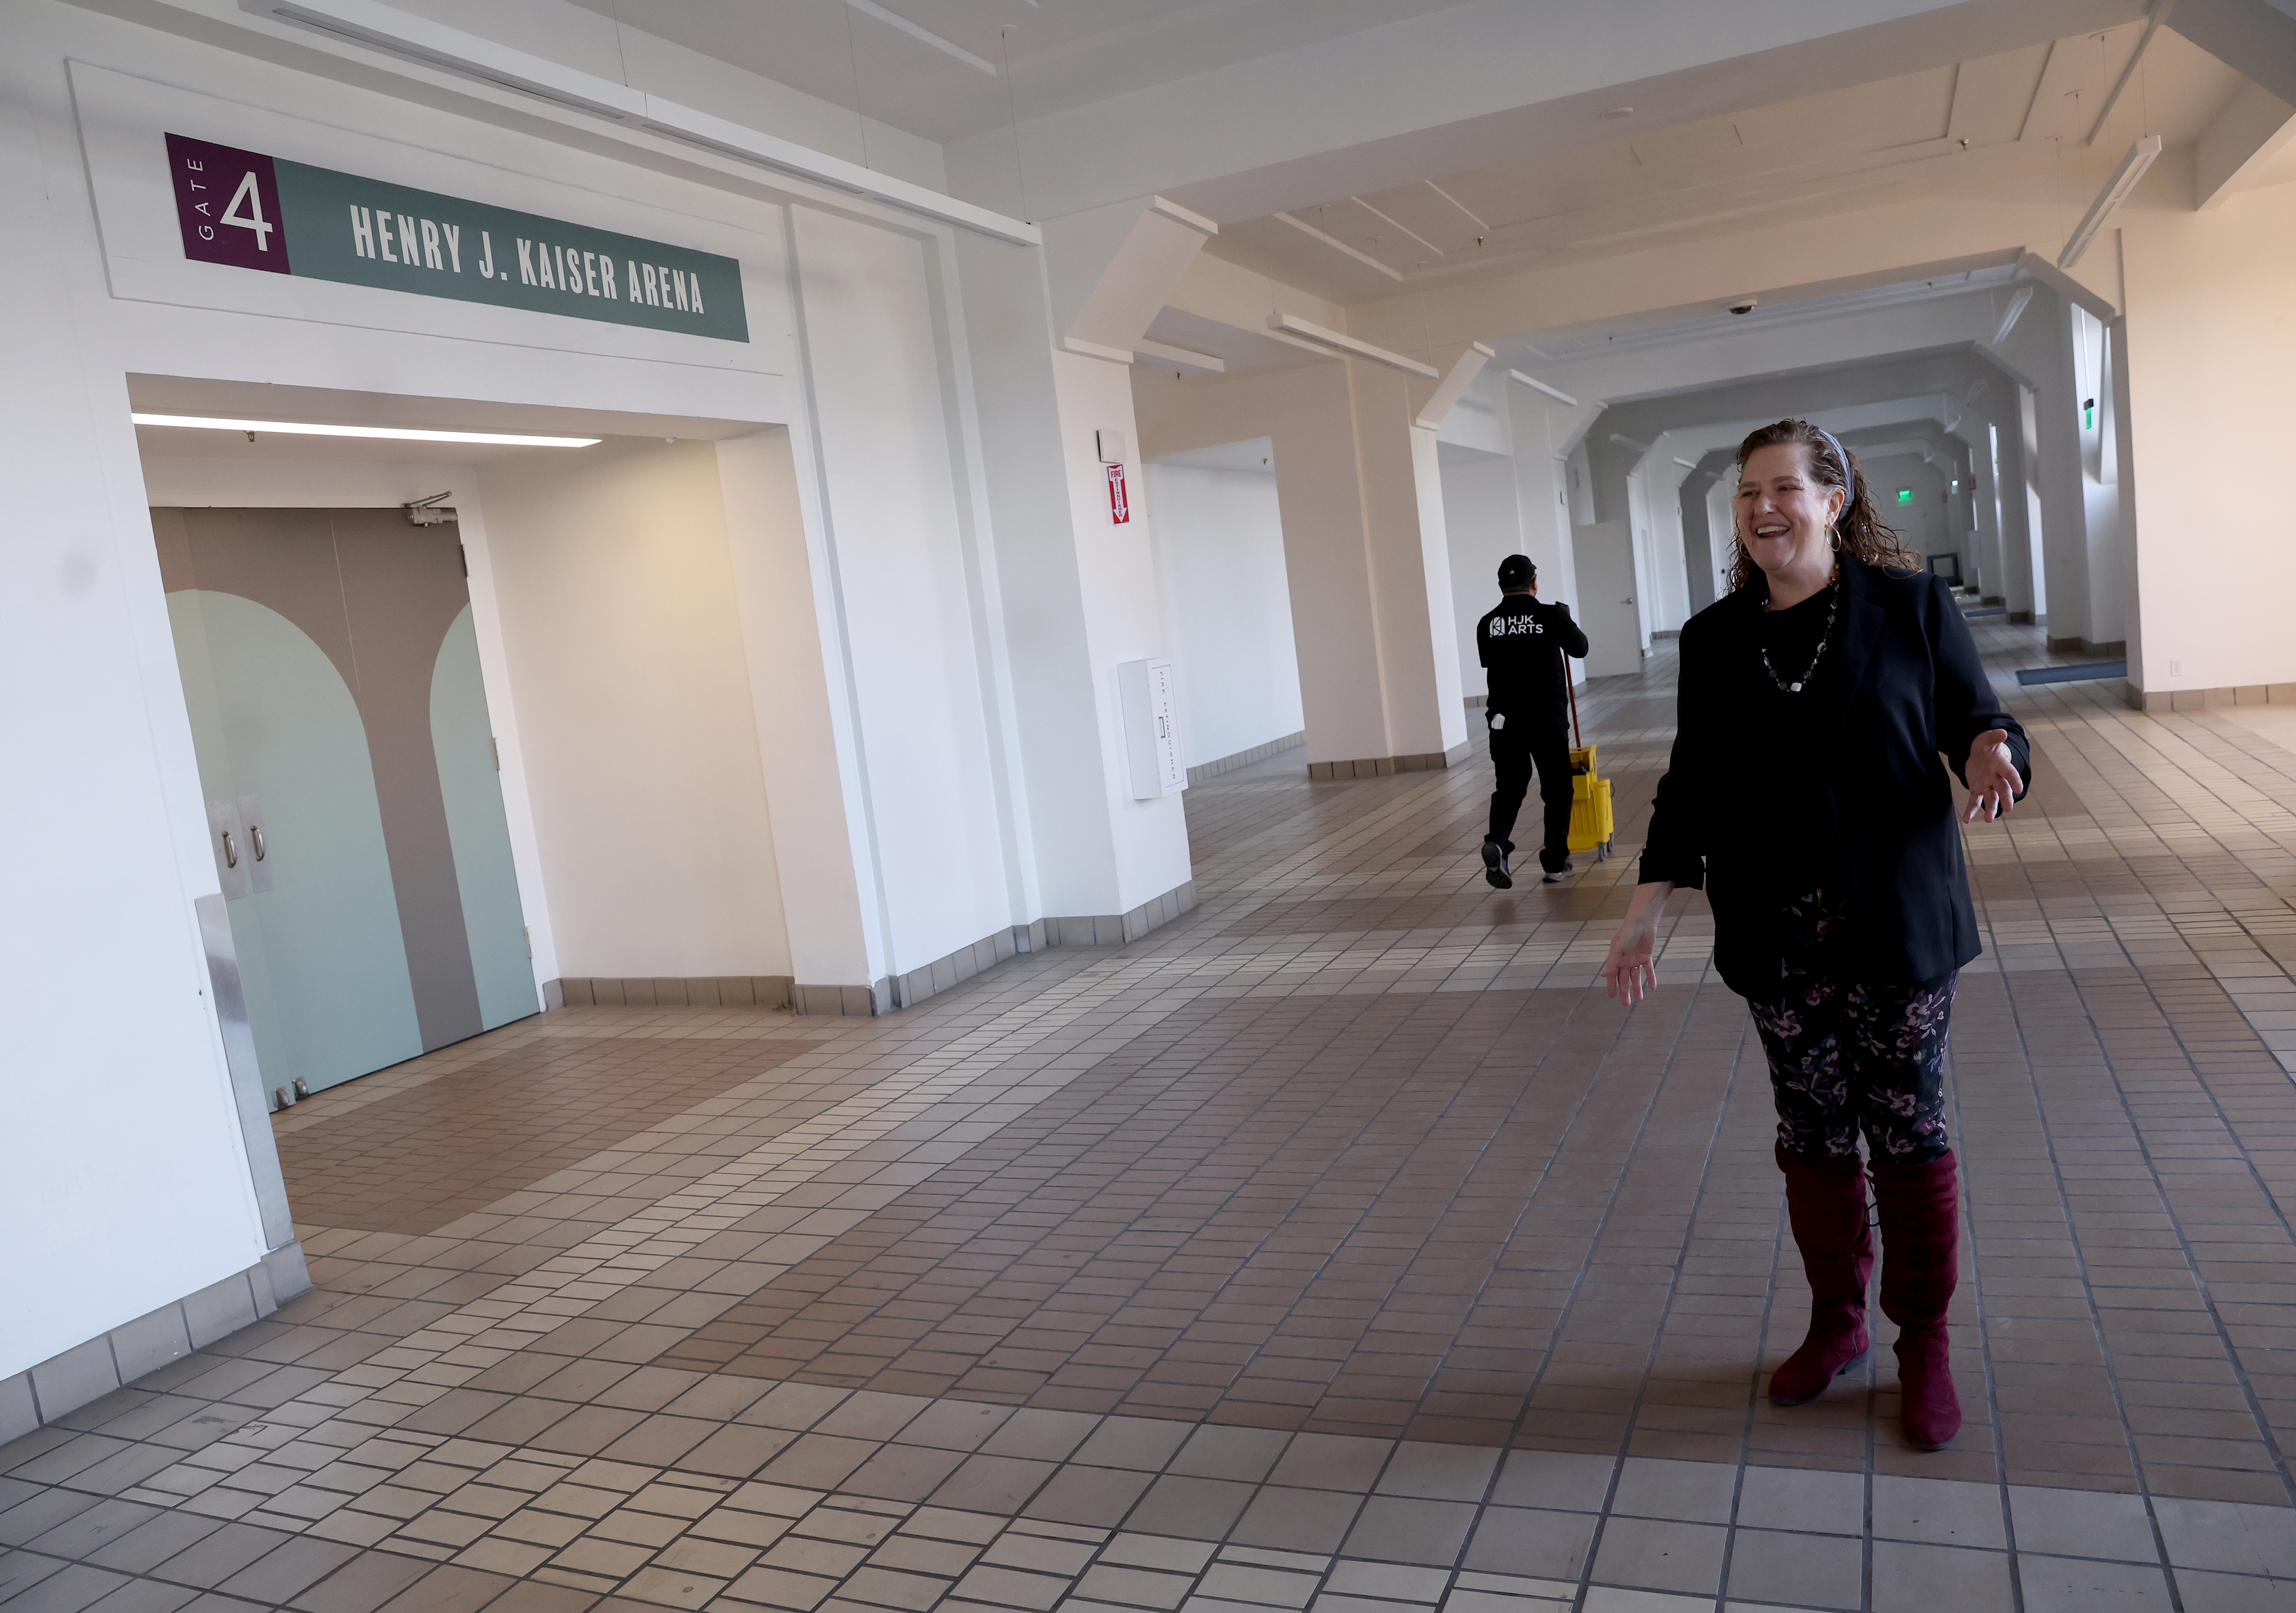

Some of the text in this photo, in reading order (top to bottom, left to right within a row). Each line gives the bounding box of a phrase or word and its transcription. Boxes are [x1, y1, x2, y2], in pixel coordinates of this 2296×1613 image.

[186, 158, 214, 241] GATE
[219, 171, 273, 252] 4
[349, 204, 705, 314] HENRY J. KAISER ARENA
[1111, 470, 1122, 478] FIRE
[1508, 615, 1534, 626] HJK
[1508, 624, 1543, 635] ARTS
